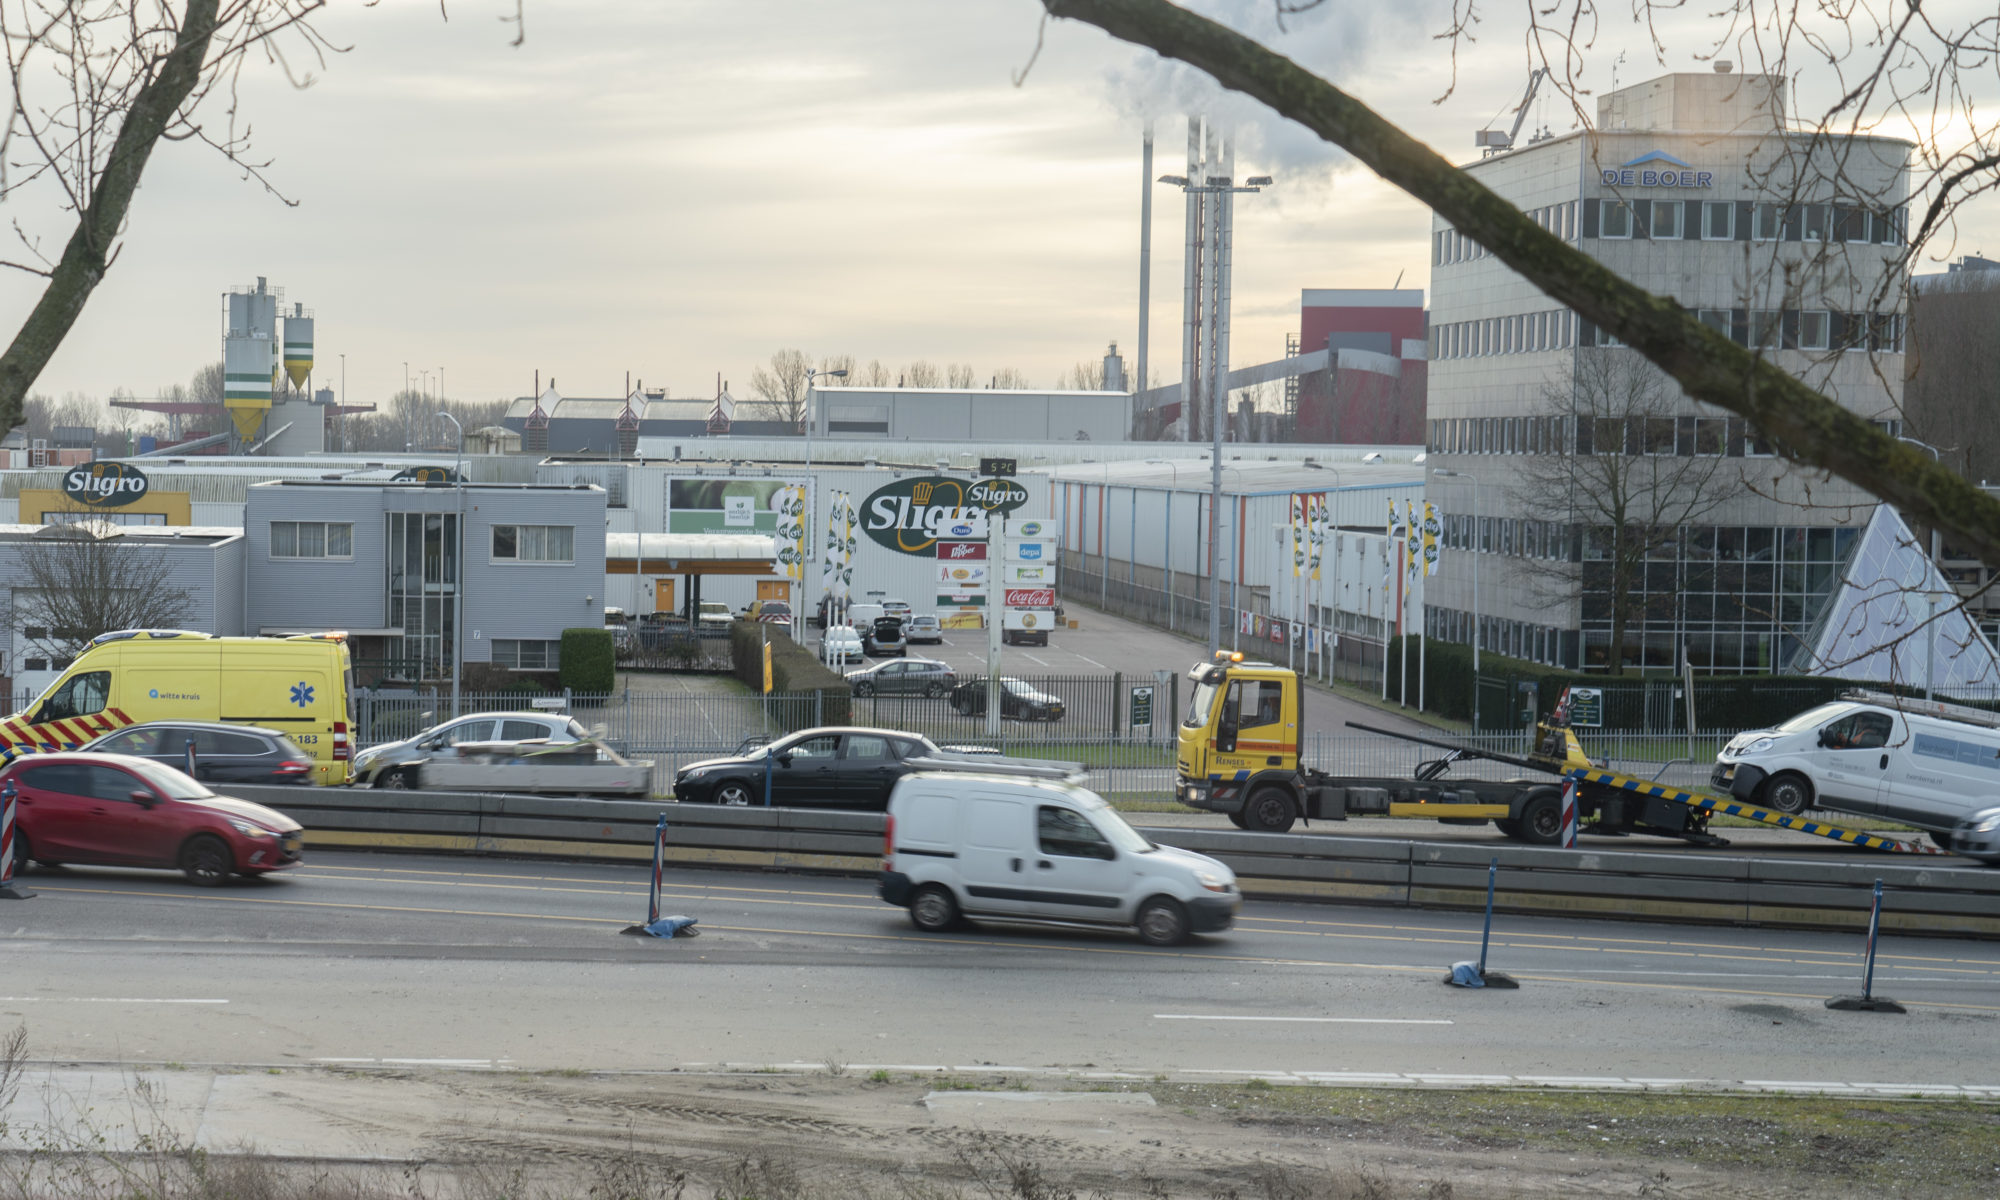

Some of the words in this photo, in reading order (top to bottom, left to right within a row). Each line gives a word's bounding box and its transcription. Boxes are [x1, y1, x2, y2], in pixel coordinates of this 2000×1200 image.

[1602, 169, 1635, 185] DE
[1641, 170, 1713, 187] BOER
[990, 462, 998, 473] 5
[67, 471, 146, 497] Sligro
[970, 486, 1026, 504] Sligro
[867, 495, 990, 538] Sligr
[181, 693, 200, 701] kruis
